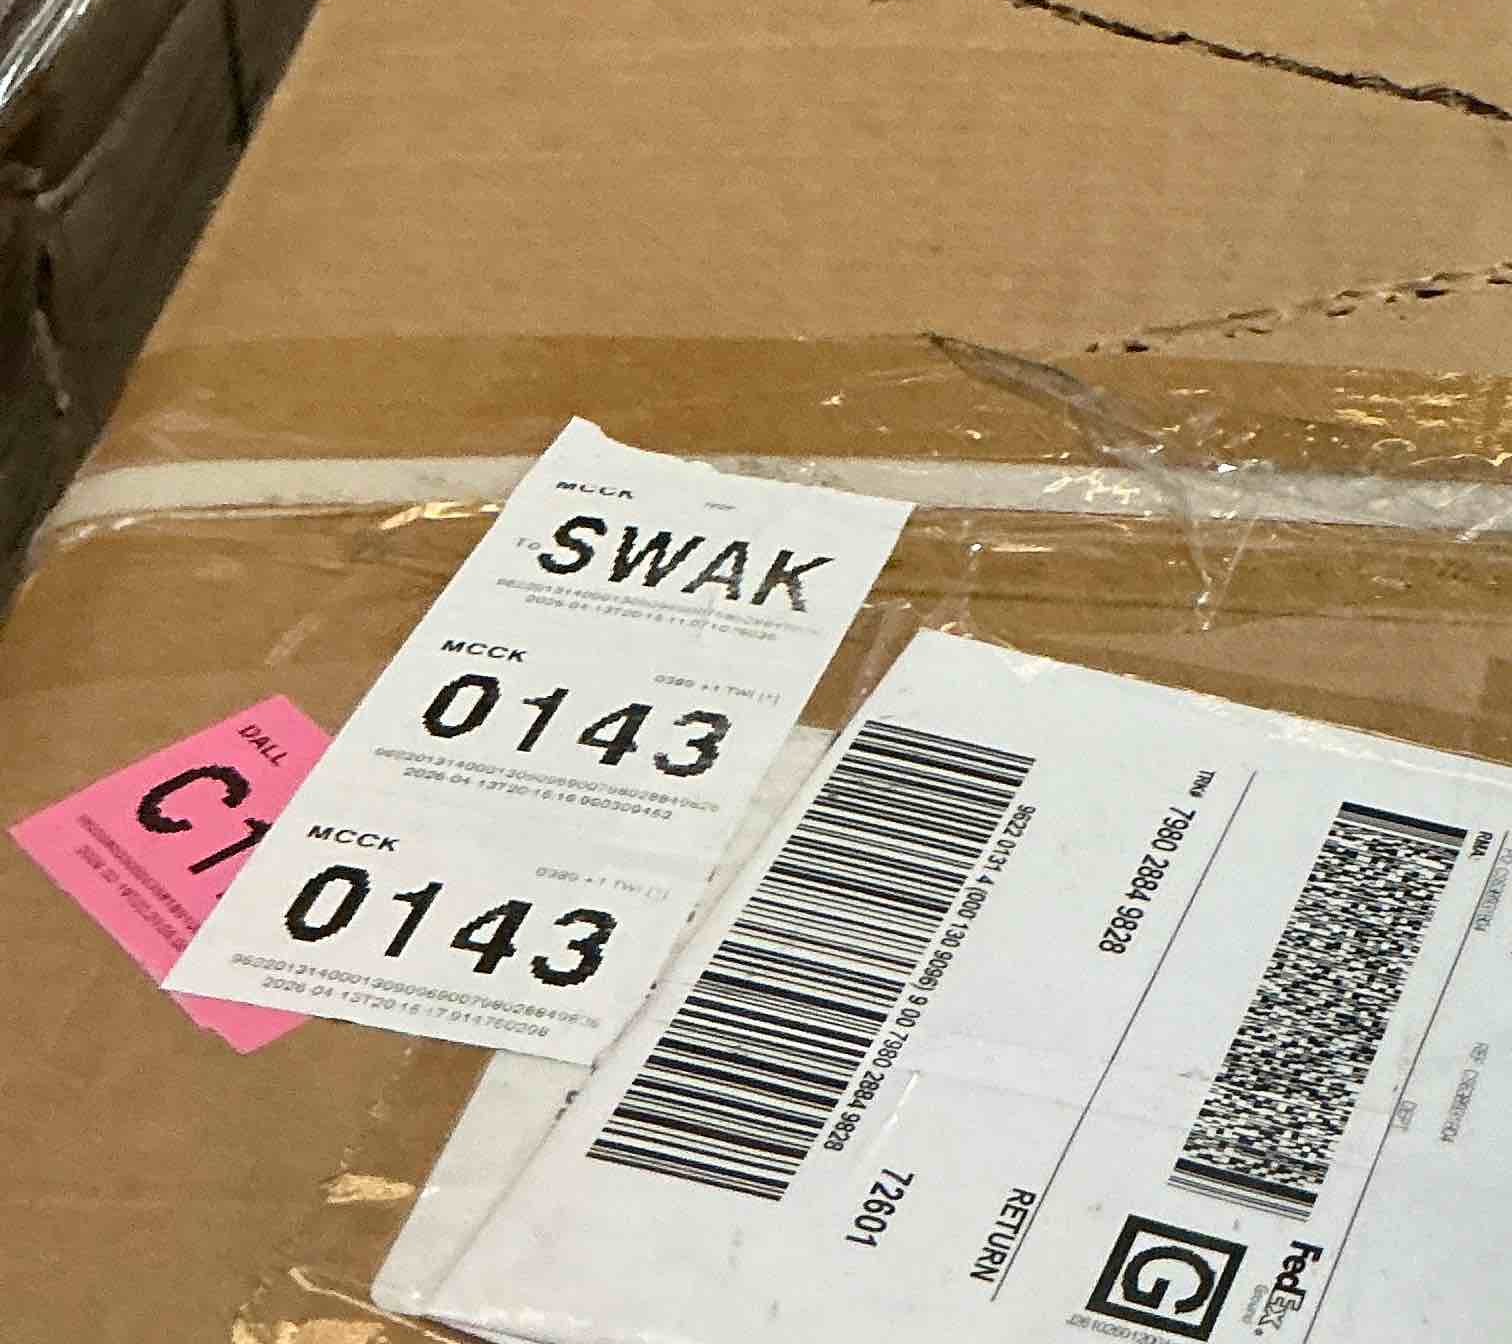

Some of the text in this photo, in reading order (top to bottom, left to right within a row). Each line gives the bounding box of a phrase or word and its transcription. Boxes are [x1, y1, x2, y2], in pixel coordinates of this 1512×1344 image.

[536, 515, 836, 613] SWAK
[440, 639, 527, 663] MCCK
[237, 723, 288, 767] DALL
[421, 673, 733, 778] 0143
[134, 761, 274, 876] C1
[306, 824, 401, 852] MCCK
[1098, 770, 1217, 955] TRK# 7980 2884 9828
[283, 864, 618, 988] 0143
[823, 804, 1037, 1152] 9622 0131 4 (000 130 9096) 9 00 7980 2884 9828
[845, 1168, 915, 1248] 72601
[970, 1187, 1037, 1284] RETURN
[1121, 1245, 1218, 1315] G
